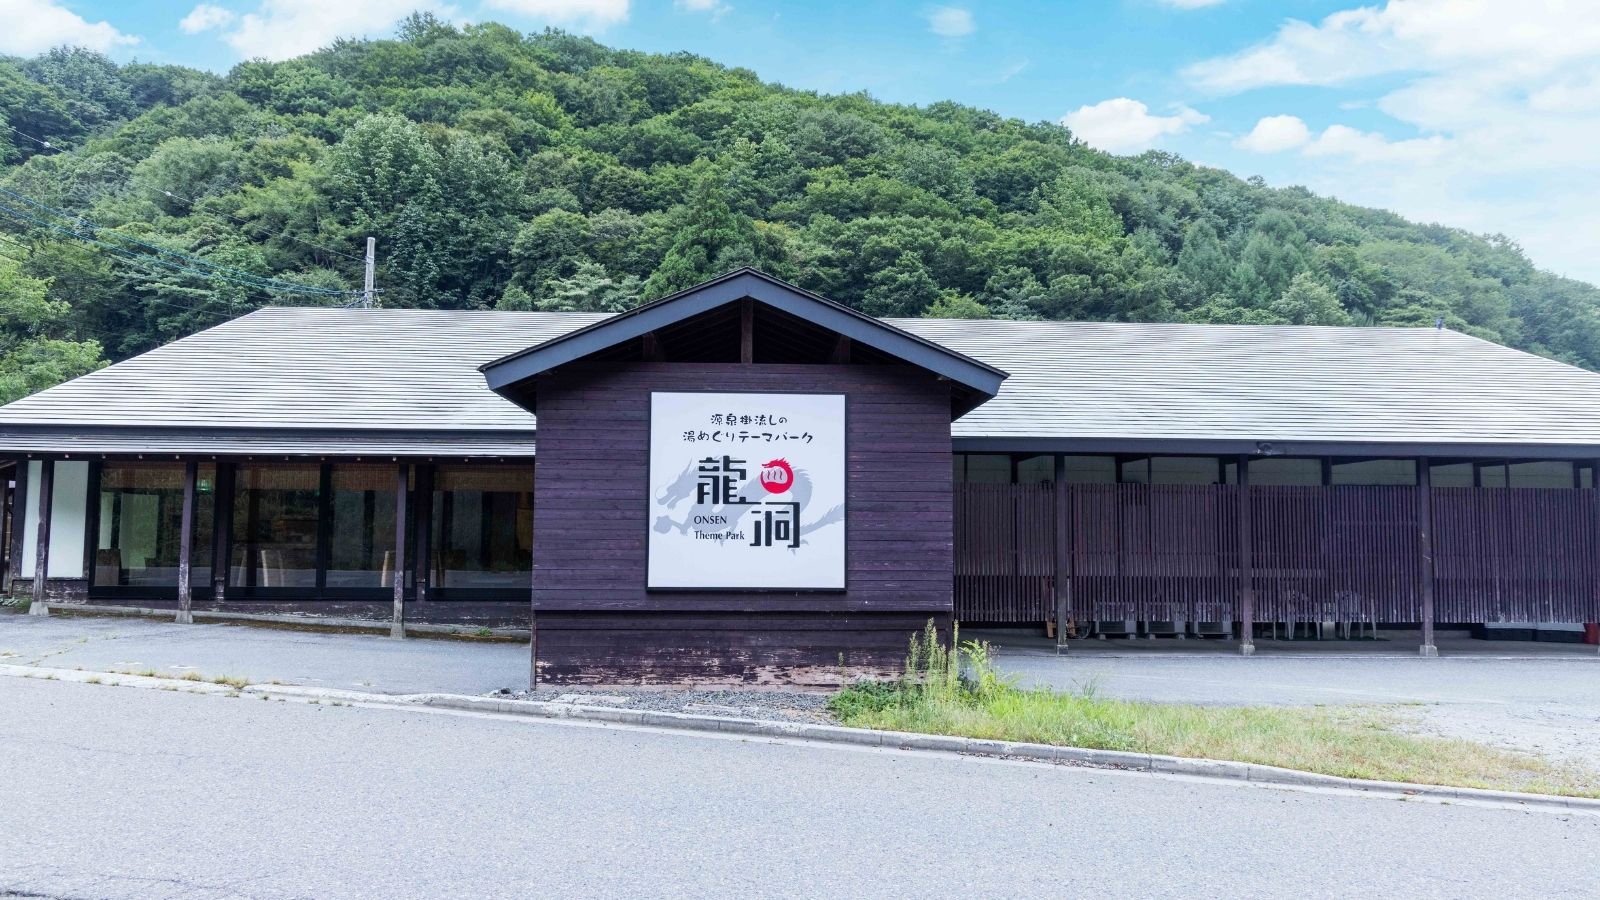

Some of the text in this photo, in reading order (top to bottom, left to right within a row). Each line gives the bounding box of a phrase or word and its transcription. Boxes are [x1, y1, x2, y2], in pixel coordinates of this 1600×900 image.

[710, 413, 788, 426] 源泉掛流しの
[682, 430, 813, 443] 湯めぐりテーマパーク
[693, 515, 728, 525] ONSEN
[694, 530, 745, 540] Theme Park
